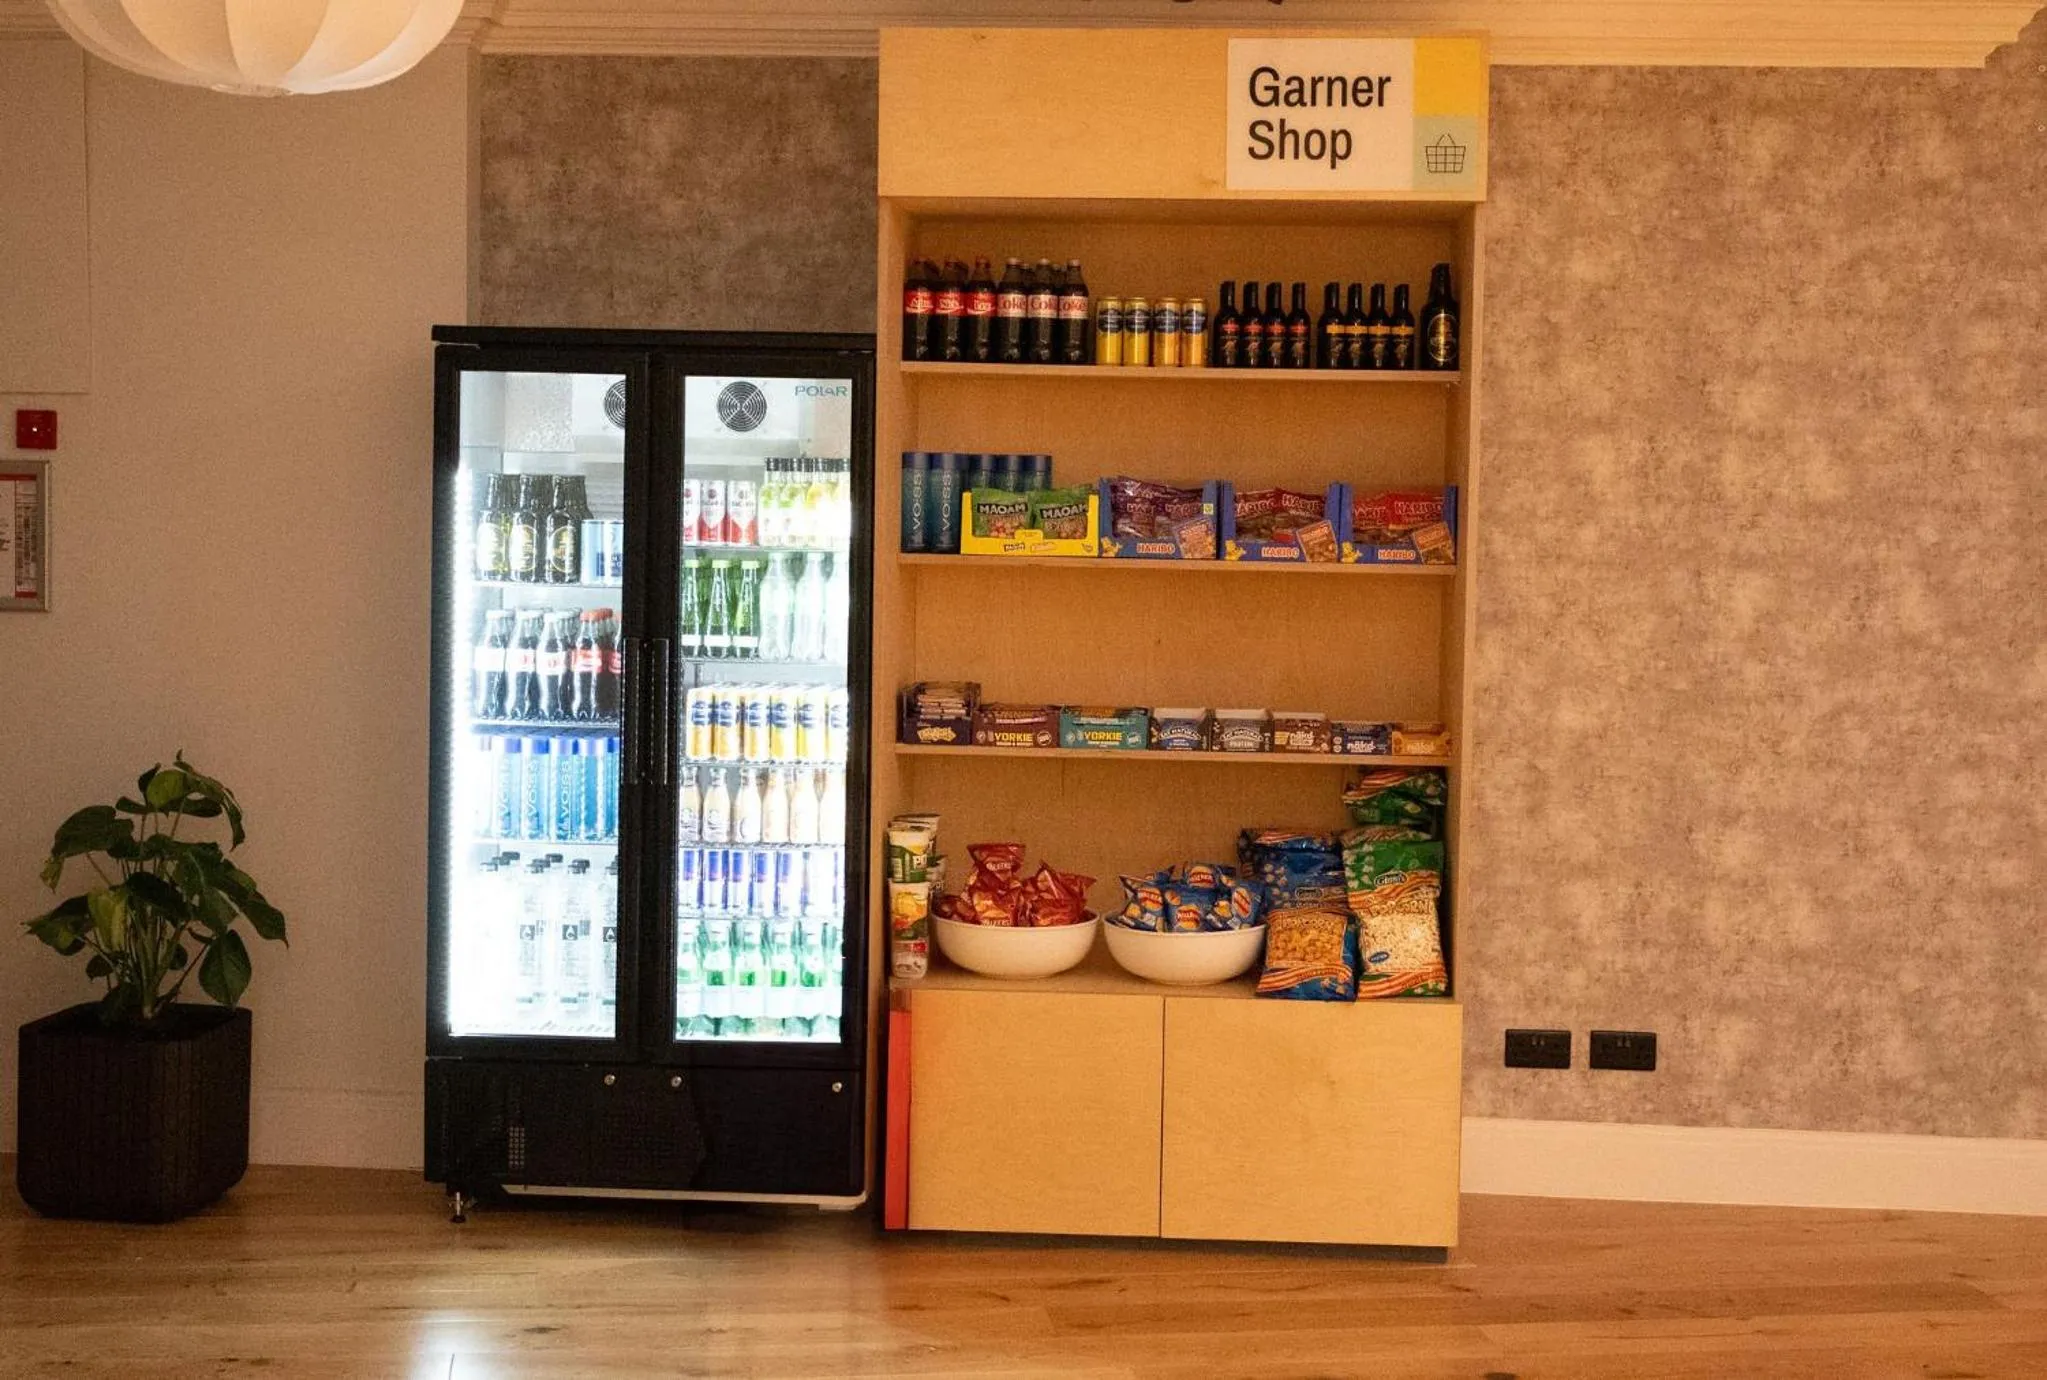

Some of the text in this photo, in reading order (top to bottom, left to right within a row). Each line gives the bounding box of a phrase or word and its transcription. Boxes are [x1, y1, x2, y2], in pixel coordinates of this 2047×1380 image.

[1249, 66, 1392, 108] Garner
[1248, 118, 1353, 170] Shop
[795, 385, 848, 397] POLAR
[912, 471, 923, 530] VOSS
[942, 471, 953, 531] VOSS
[979, 503, 1027, 515] MAOAM
[1136, 542, 1176, 554] HARIBO
[1261, 546, 1300, 559] HARIBO
[1377, 549, 1416, 561] HARIBO
[994, 732, 1034, 743] YORKIE
[1084, 731, 1123, 742] YORKIE
